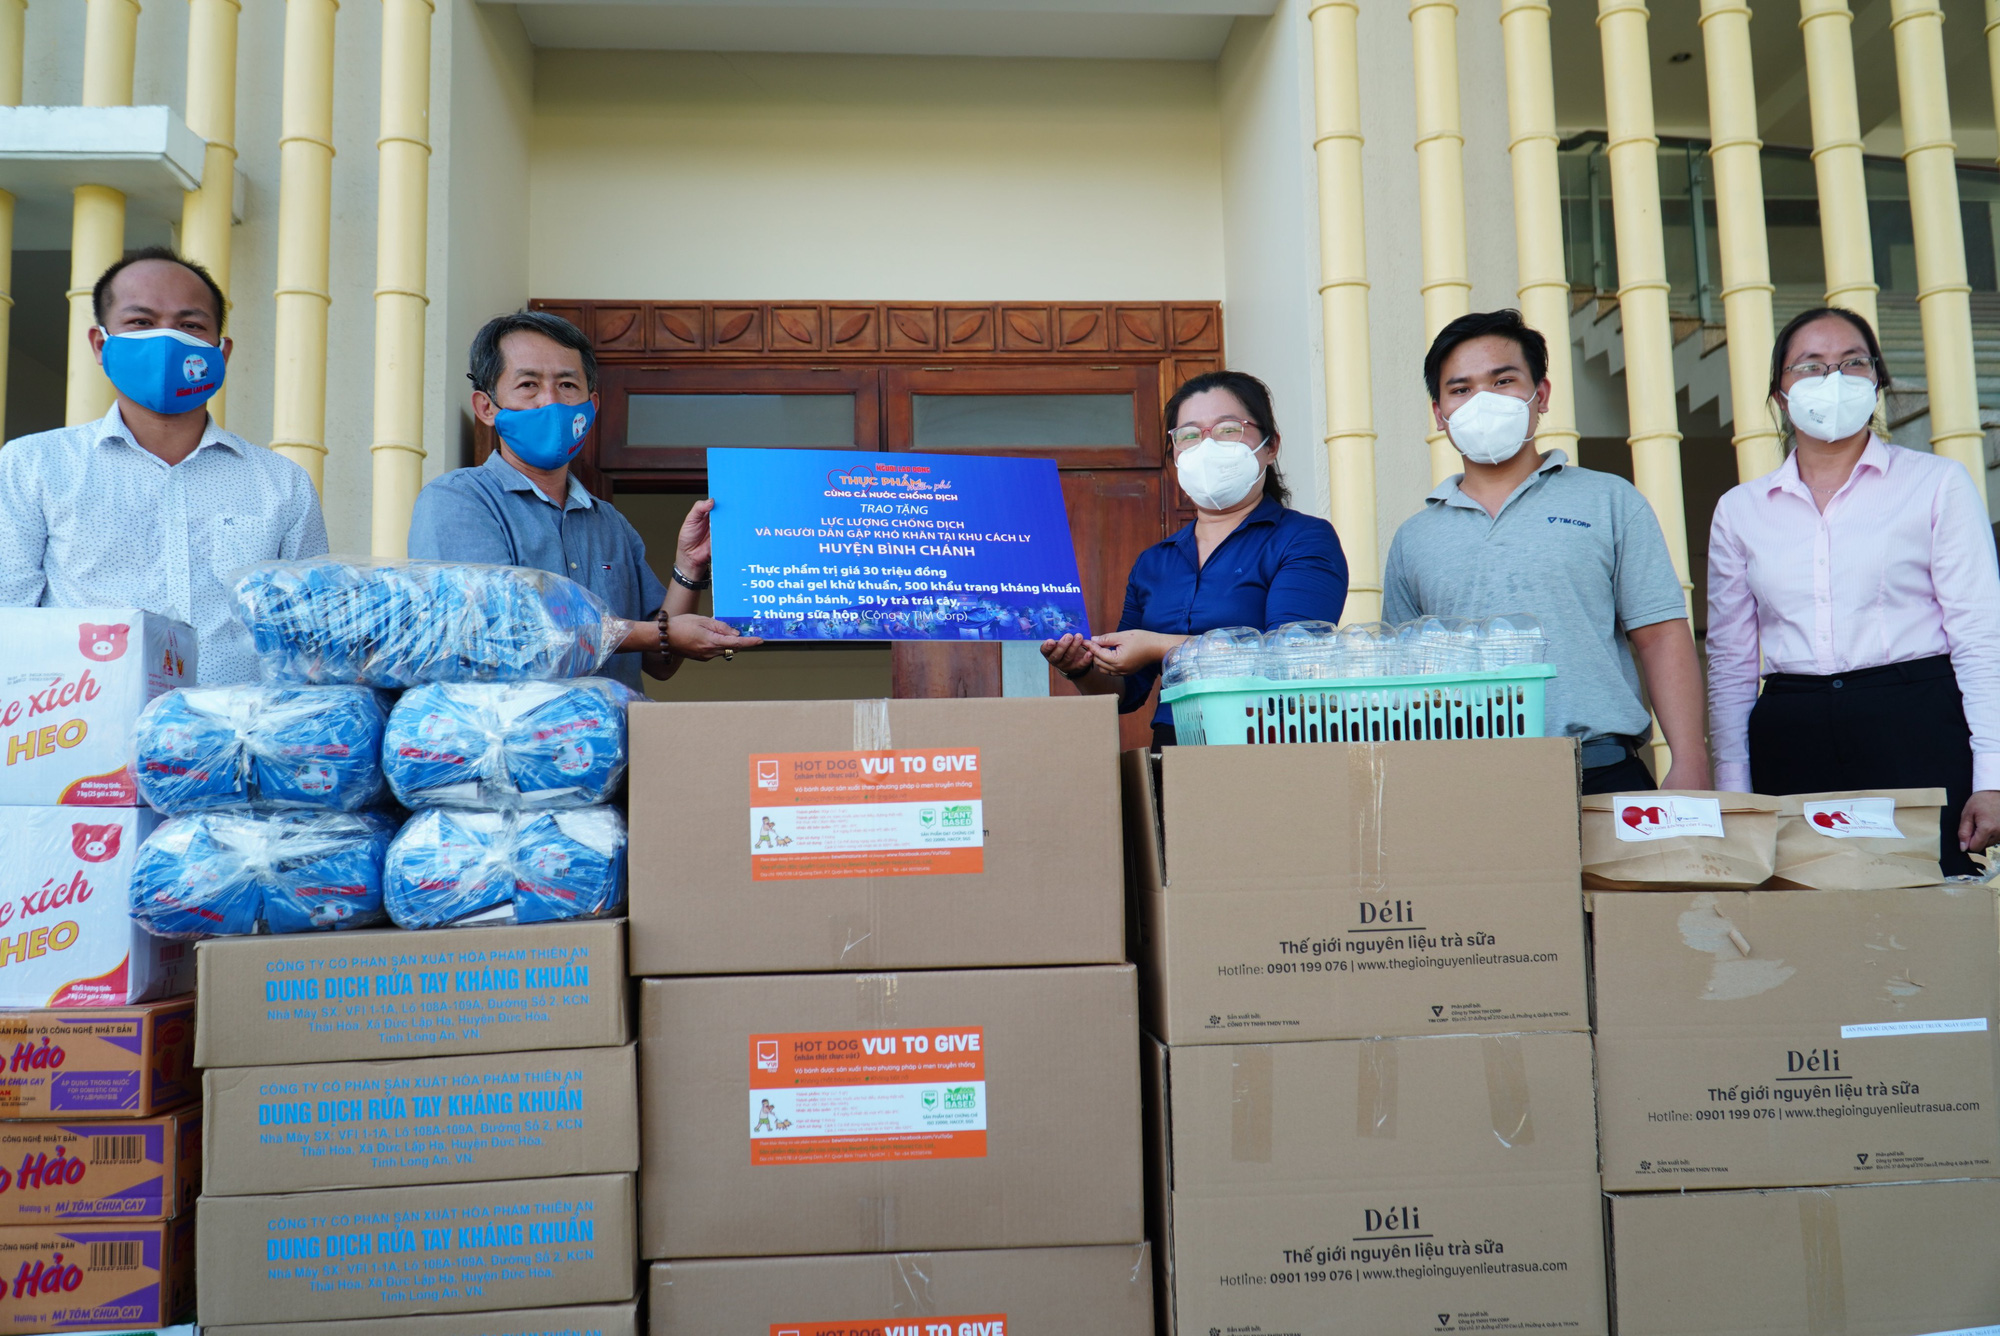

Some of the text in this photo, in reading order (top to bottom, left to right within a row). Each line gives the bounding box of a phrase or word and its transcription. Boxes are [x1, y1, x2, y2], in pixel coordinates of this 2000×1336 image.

[839, 474, 922, 487] THỰC PHẨM
[824, 490, 958, 502] CÙNG CẢ NƯỚC CHỐNG DỊCH
[860, 503, 928, 515] TRAO TẶNG
[754, 526, 1030, 542] VÀ NGƯỜI DÂN GẶP KHÓ KHĂN TẠI KHU CÁCH LY
[820, 516, 964, 529] LỰC LƯỢNG CHỐNG DỊCH
[1573, 519, 1591, 528] CORP
[818, 541, 975, 556] HUYỆN BÌNH CHÁNH
[748, 563, 946, 578] Thực phẩm trị giá 30 triệu đồng
[750, 579, 1080, 594] 500 chai gel khử khuẩn, 500 khẩu trang kháng khuẩn
[751, 593, 960, 608] 100 phần bánh, 50 ly trà trái cây,
[752, 609, 968, 623] 2 thùng sữa hộp (Công ty TIM Corp)
[28, 668, 101, 717] xích
[7, 719, 88, 766] HEO
[794, 754, 977, 774] HOT DOG VUI TO GIVE
[20, 870, 93, 919] xích
[1359, 900, 1412, 923] Déli
[0, 920, 79, 968] HEO
[1279, 931, 1495, 956] Thế giới nguyên liệu trà sữa
[1218, 953, 1558, 975] Hotline: 0901 199 076 www.thegioinguyenlieutrasua.com
[265, 955, 589, 1003] DUNG DỊCH RỬA TAY KHÁNG KHUẨN
[10, 1036, 65, 1072] Hảo
[794, 1034, 981, 1055] HOT DOG VUI TO GIVE
[1787, 1048, 1839, 1071] Déli
[258, 1079, 583, 1127] DUNG DỊCH RỬA TAY KHÁNG KHUẨN
[1708, 1080, 1919, 1103] Thế giới nguyên liệu trà sữa
[1647, 1102, 1979, 1121] Hotline: 0901 199 076 www.thegioinguyenlieutrasua.com
[339, 1129, 358, 1140] VFI
[557, 1118, 583, 1130] KCN
[17, 1145, 86, 1190] Hảo
[1364, 1206, 1419, 1231] Déli
[266, 1212, 594, 1263] DUNG DỊCH RỬA TAY KHÁNG KHUẨN
[1283, 1238, 1503, 1264] Thế giới nguyên liệu trà sữa
[13, 1252, 83, 1298] Hảo
[1219, 1262, 1567, 1285] Hotline: 0901 199 076 www.thegioinguyenlieutrasua.com
